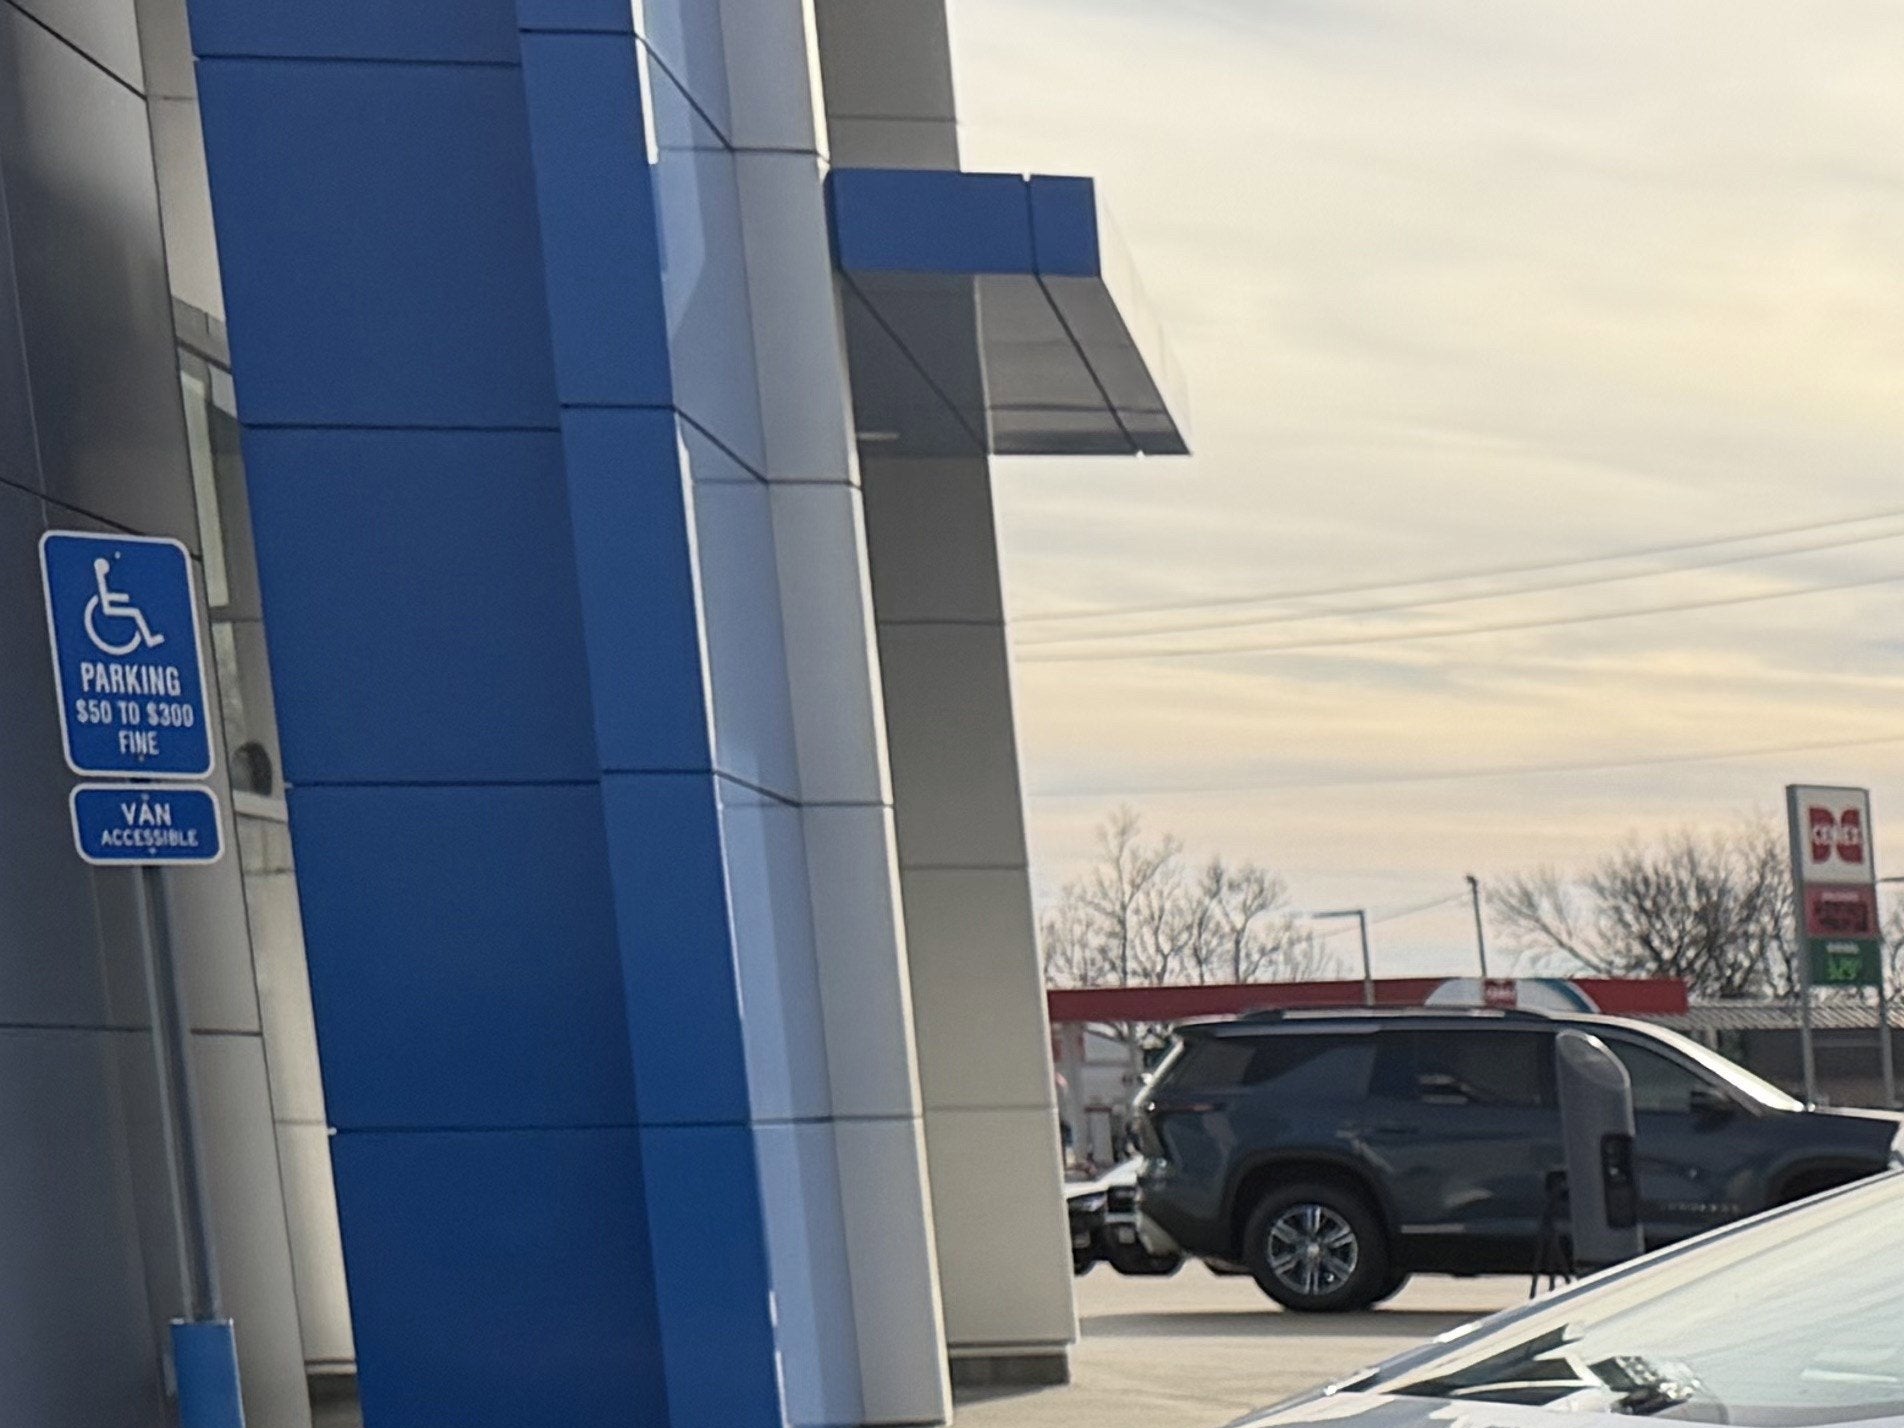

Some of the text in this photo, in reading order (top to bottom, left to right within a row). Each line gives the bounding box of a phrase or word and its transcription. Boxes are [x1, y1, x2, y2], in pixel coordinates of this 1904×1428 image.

[80, 662, 181, 696] PARKING
[76, 699, 194, 727] $50 TO $300
[118, 730, 160, 755] FINE
[121, 803, 172, 826] VAN
[101, 829, 199, 847] ACCESSIBLE
